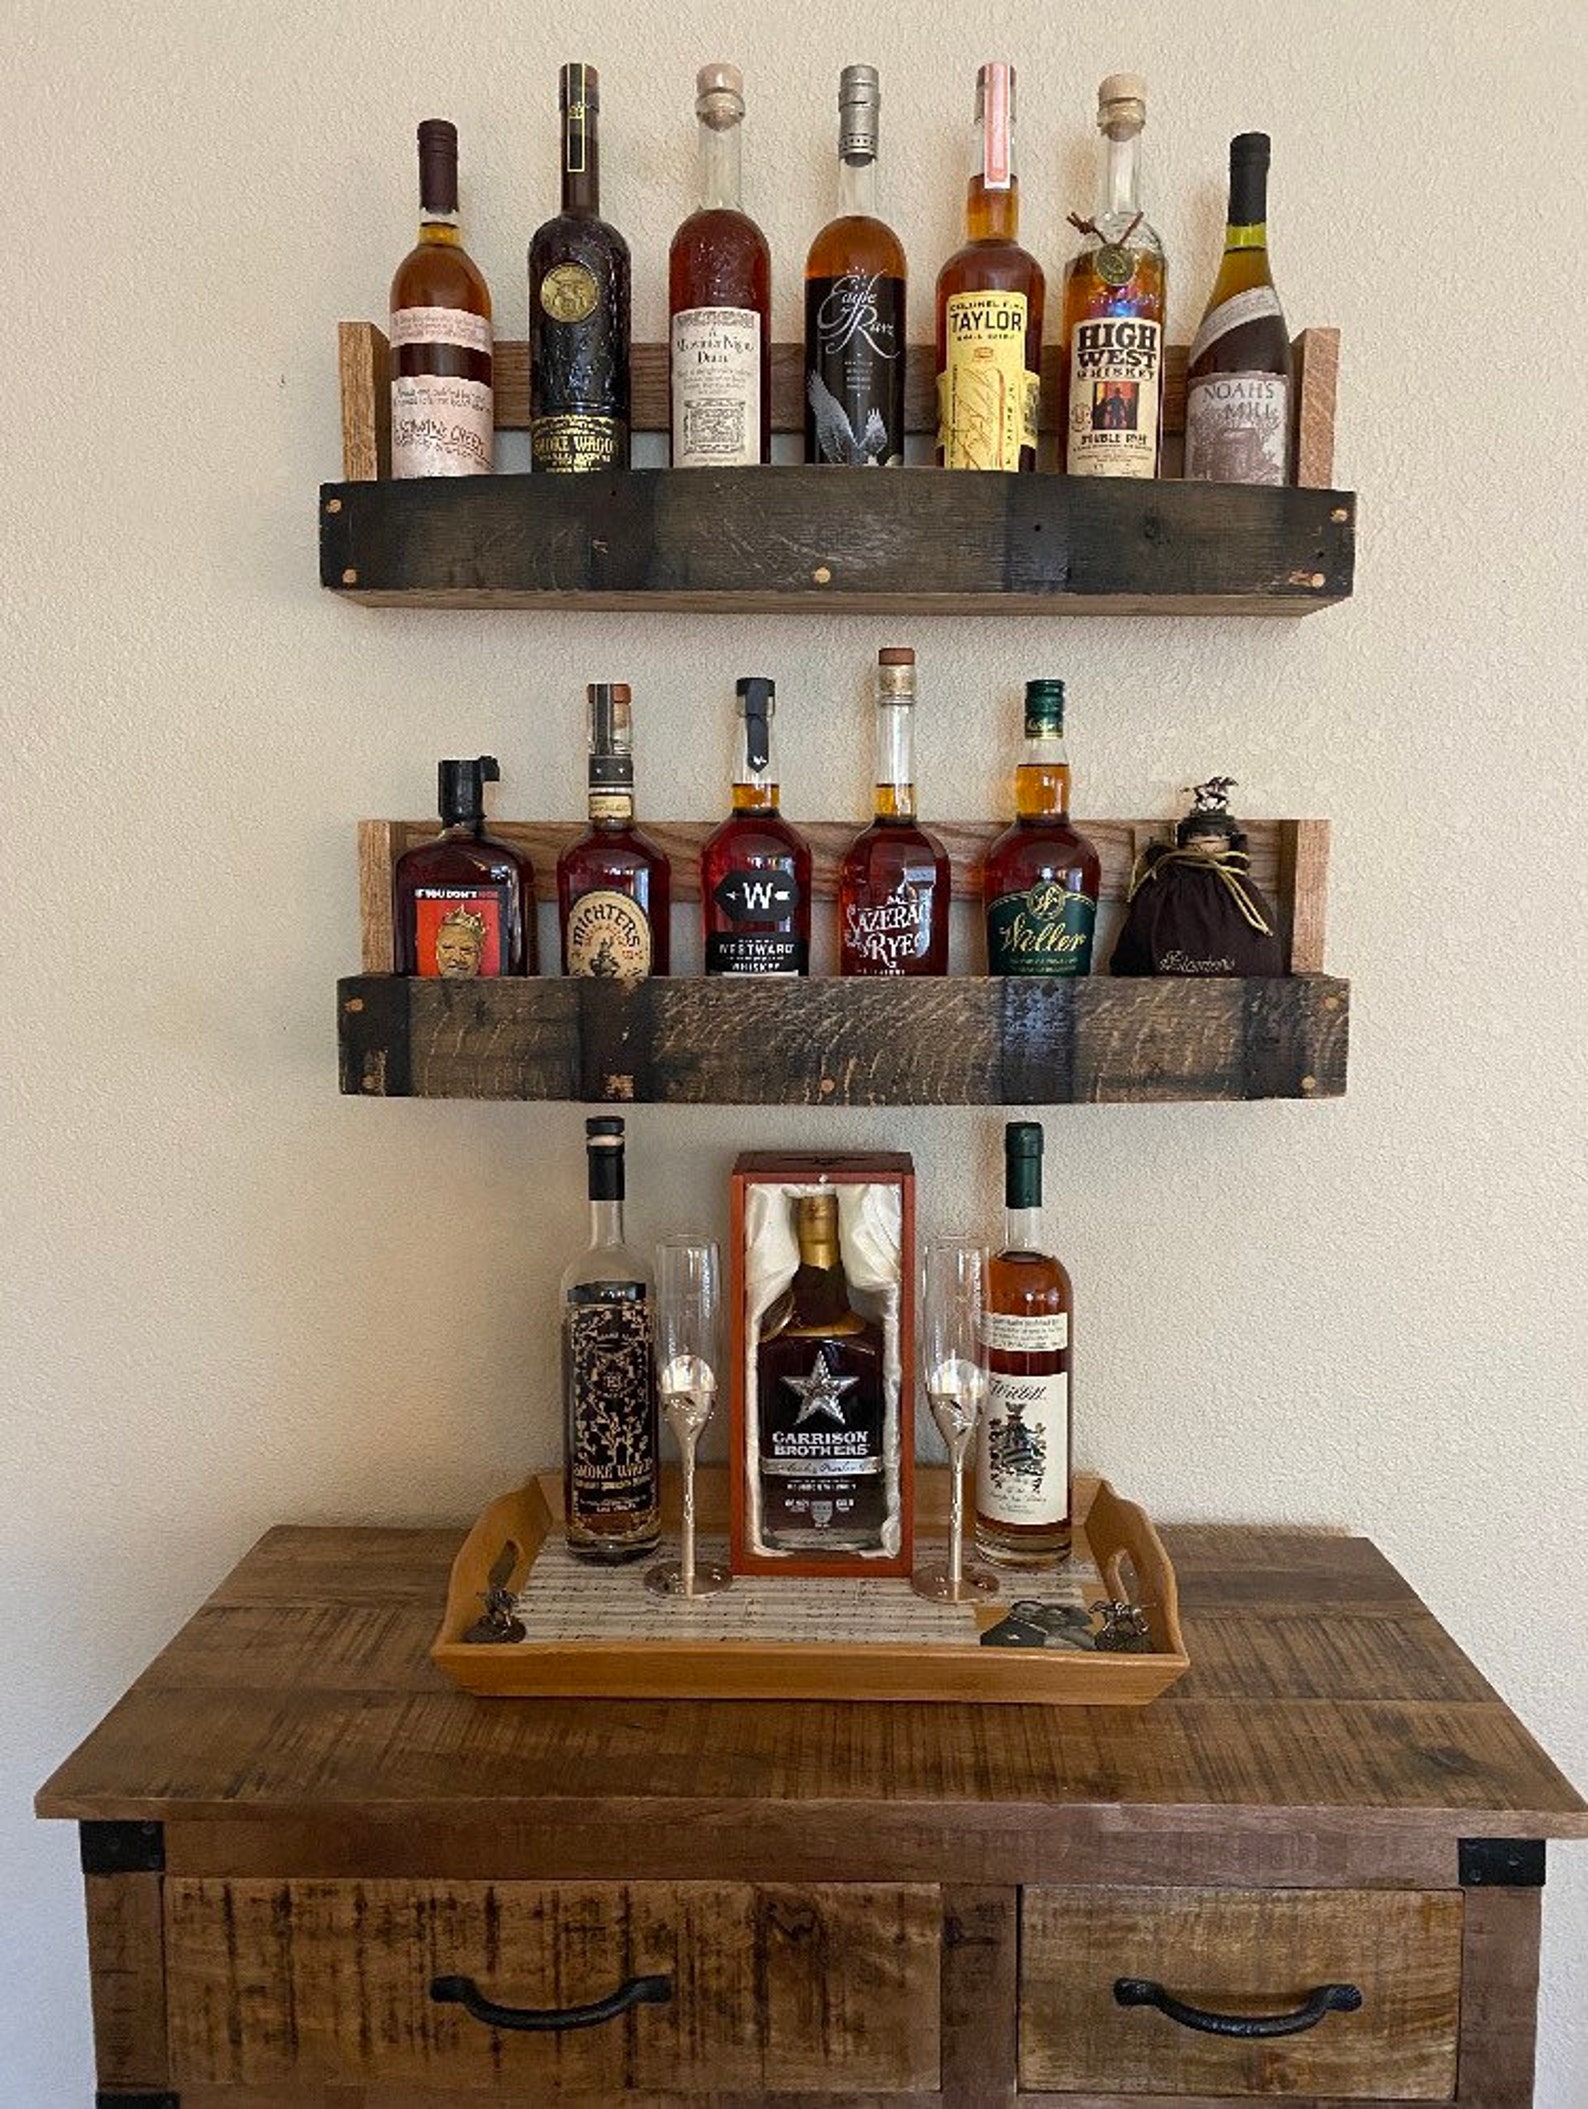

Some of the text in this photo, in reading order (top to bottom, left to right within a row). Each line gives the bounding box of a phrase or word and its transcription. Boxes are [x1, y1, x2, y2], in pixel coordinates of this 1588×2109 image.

[950, 310, 1022, 333] TAYLOR
[1078, 322, 1157, 351] HIGH
[1077, 349, 1157, 369] WEST
[1077, 367, 1154, 381] WHISKEY
[742, 882, 774, 910] W
[999, 912, 1087, 952] Weller
[719, 943, 795, 956] WESTWARD
[866, 931, 915, 968] RYE
[772, 1430, 869, 1446] GARRISON
[774, 1444, 870, 1457] BROTHERS
